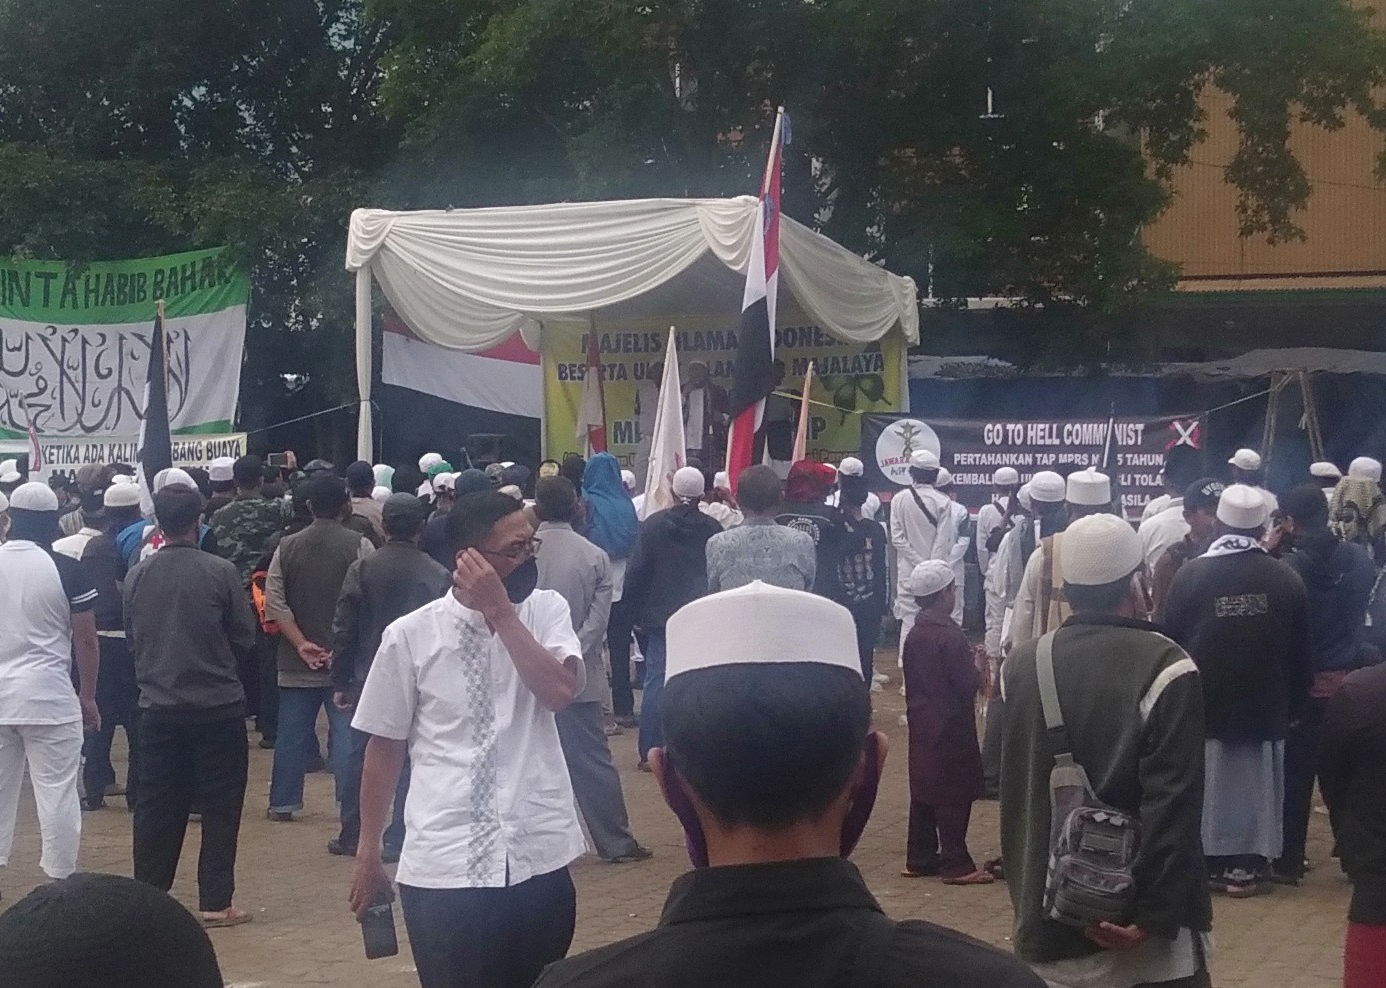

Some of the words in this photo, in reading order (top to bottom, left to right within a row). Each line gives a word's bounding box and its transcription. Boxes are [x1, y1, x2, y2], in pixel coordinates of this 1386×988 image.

[84, 272, 147, 309] HABIB
[983, 424, 1003, 446] GO
[1006, 424, 1024, 446] TO
[1026, 424, 1060, 446] HELL
[42, 444, 80, 464] KETIKA
[83, 443, 105, 464] ADA
[206, 439, 241, 460] BUAYA
[953, 453, 1033, 466] PERTAHANKAN
[1035, 454, 1056, 466] TAP
[1058, 454, 1089, 466] MPRS
[1125, 454, 1164, 466] TAHUN
[1133, 474, 1164, 486] TOLA
